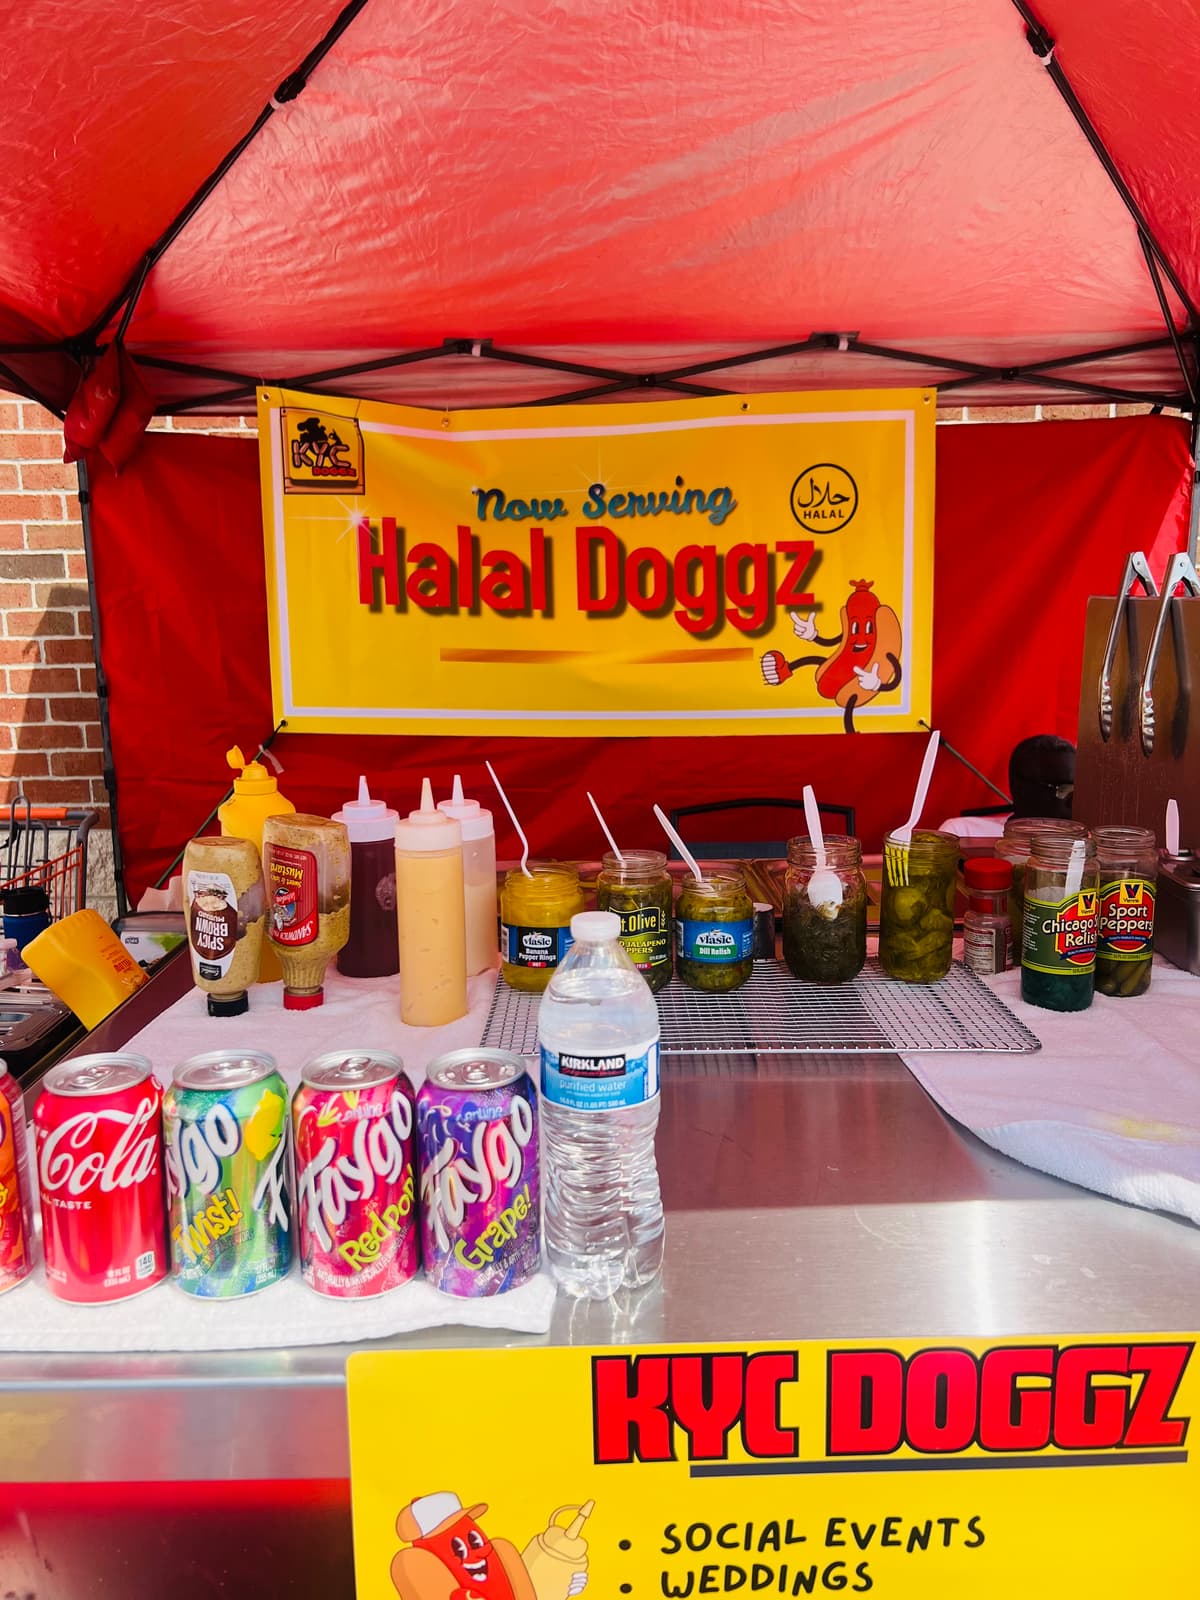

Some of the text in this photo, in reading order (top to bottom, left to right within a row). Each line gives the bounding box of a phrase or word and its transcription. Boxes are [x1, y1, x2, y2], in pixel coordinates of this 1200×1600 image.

[292, 440, 351, 468] KYC
[475, 475, 736, 525] Now Serving
[798, 478, 850, 508] حلال
[803, 509, 844, 519] HALAL
[357, 516, 818, 634] Halal Doggz
[1109, 904, 1148, 920] Sport
[195, 916, 228, 937] BROWN
[629, 914, 656, 932] Olive
[1042, 919, 1094, 933] Chicago
[1100, 917, 1153, 933] Peppers
[197, 932, 224, 951] SPICY
[699, 947, 732, 955] Dill Relish
[519, 952, 538, 961] Pepper
[561, 1055, 625, 1070] KIRKLAND
[560, 1079, 627, 1092] purified water
[299, 1091, 413, 1253] Faygo
[422, 1095, 532, 1253] Faygo
[52, 1198, 92, 1210] TASTE
[172, 1188, 242, 1263] Twist!
[454, 1183, 531, 1270] Grape!
[591, 1341, 1197, 1465] KYC DOGGZ
[660, 1515, 986, 1555] SOCIAL EVENTS
[660, 1561, 874, 1600] WEDDINGS
